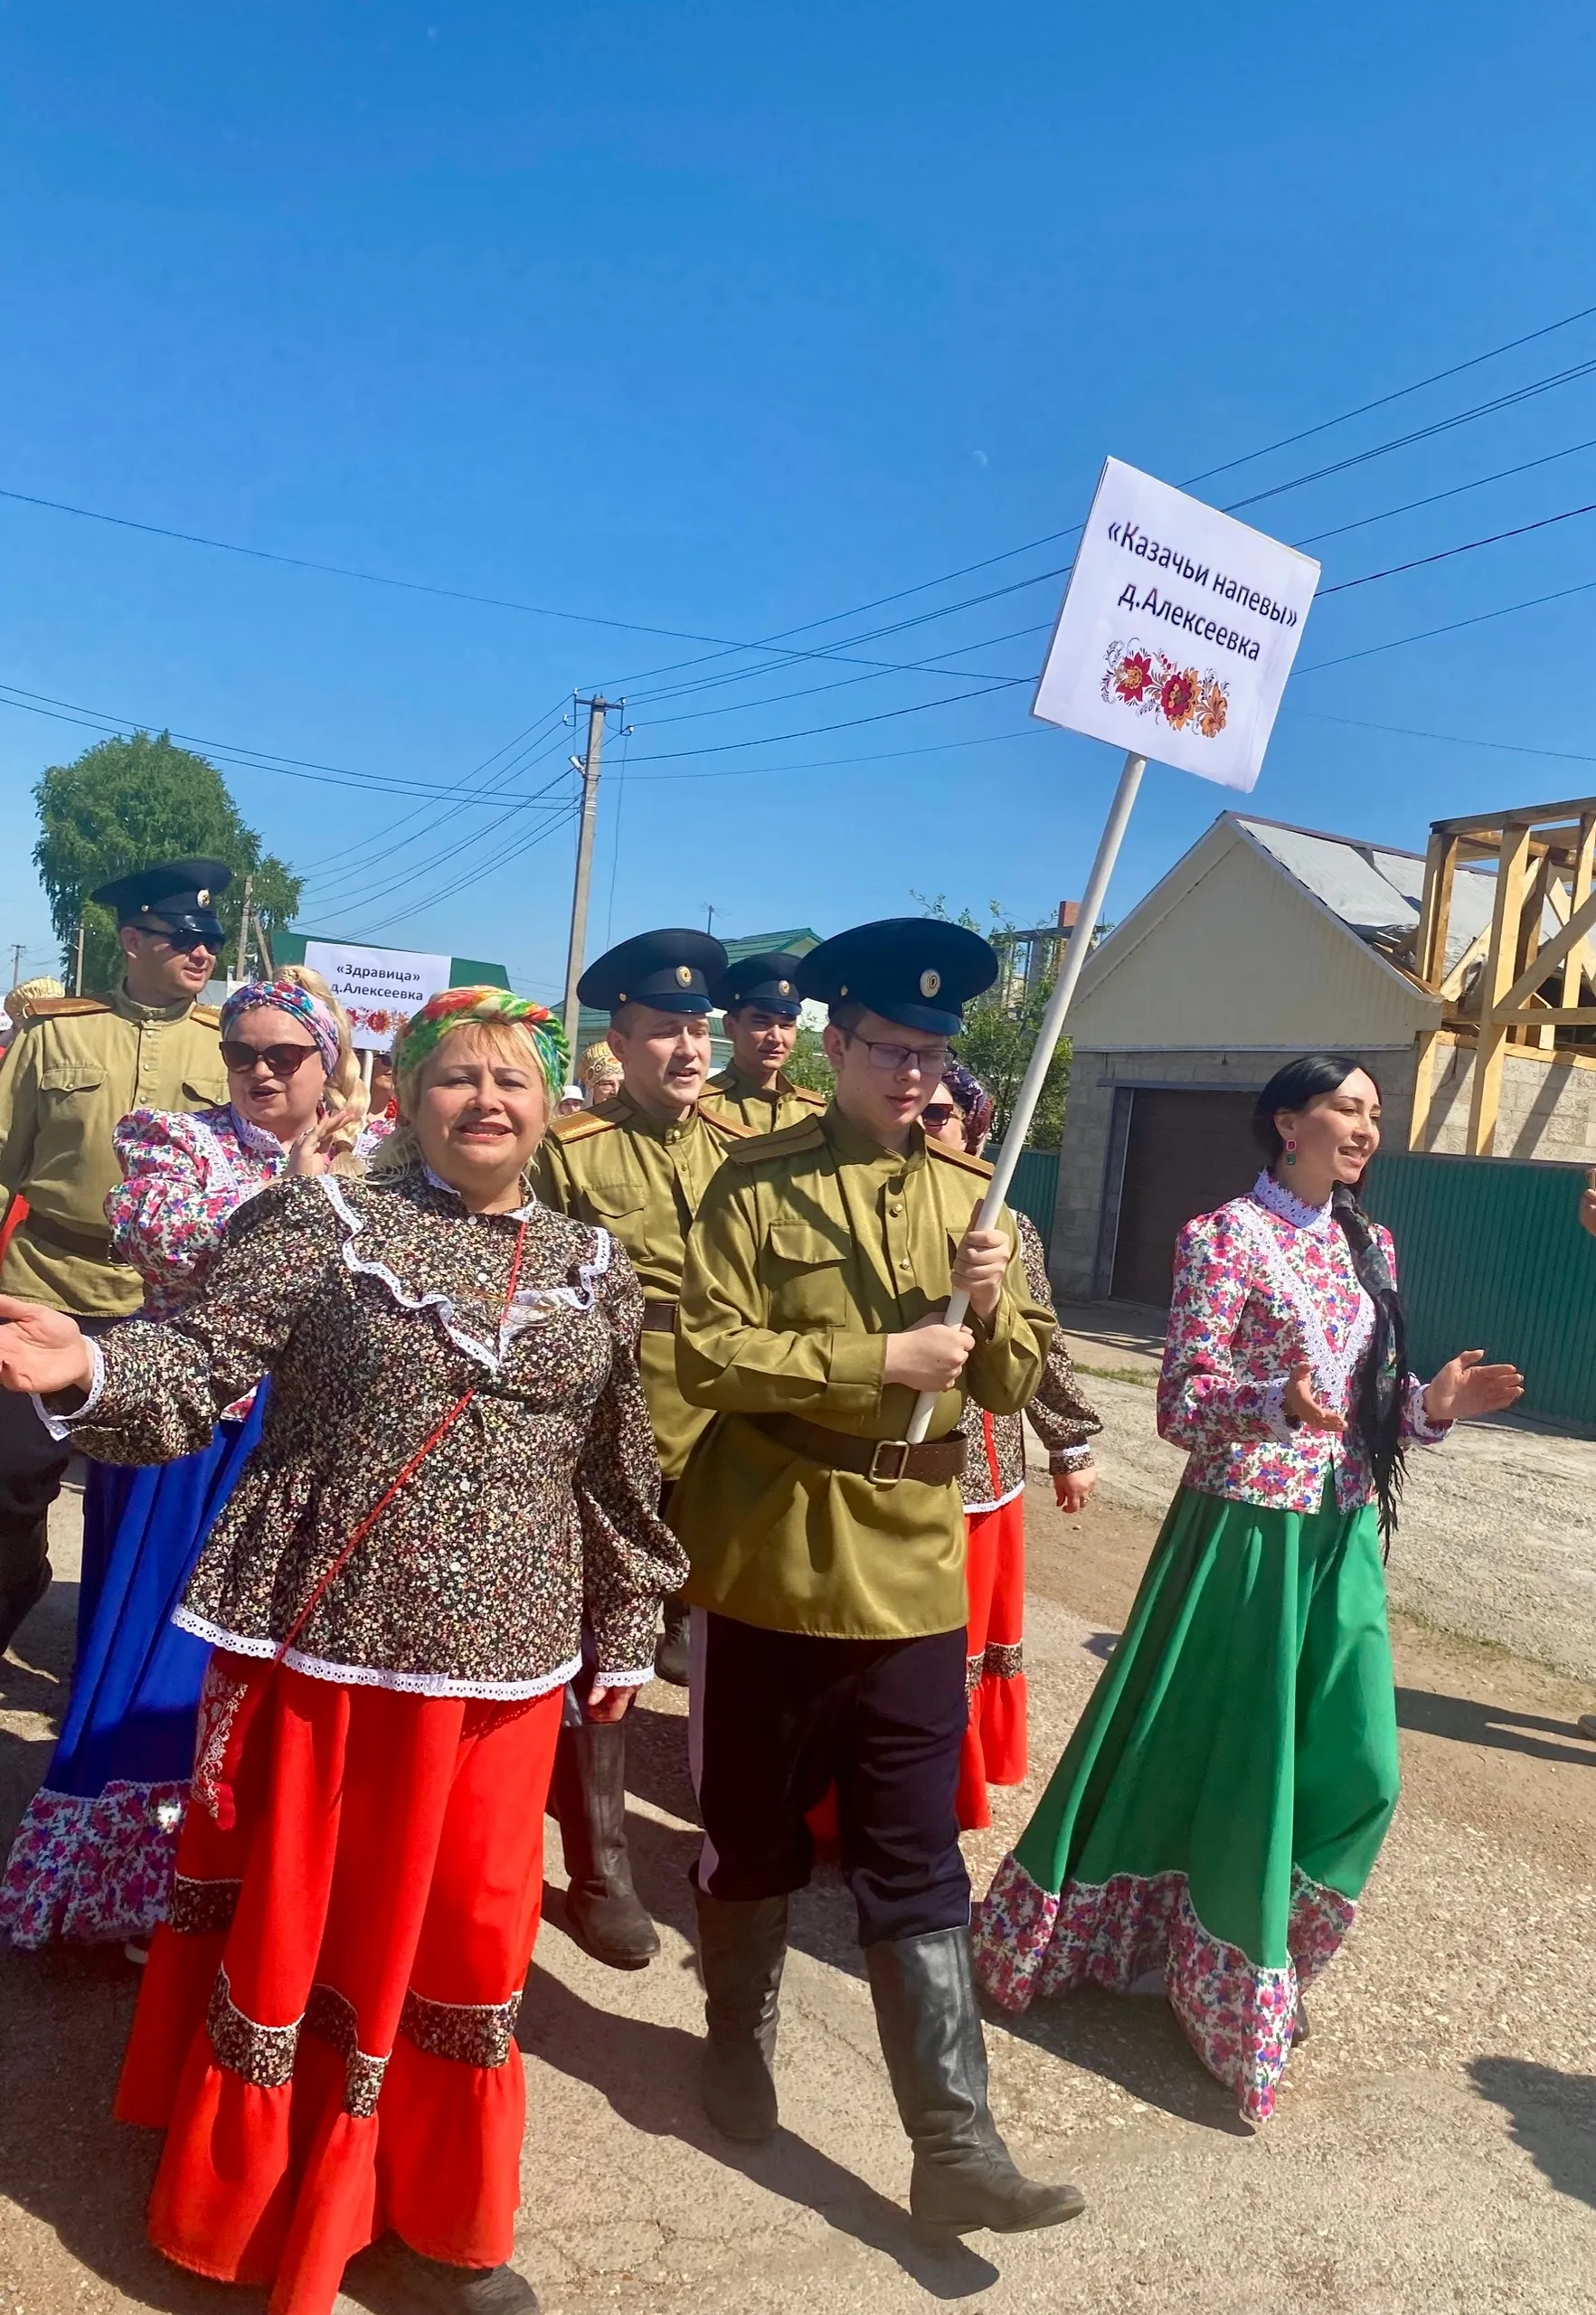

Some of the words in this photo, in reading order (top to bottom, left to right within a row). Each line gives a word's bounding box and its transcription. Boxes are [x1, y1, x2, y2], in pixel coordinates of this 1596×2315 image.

[1108, 521, 1210, 587] «Казачьи
[1213, 572, 1299, 628] напевы»
[1118, 582, 1261, 661] д.Алексеевка
[331, 982, 423, 1001] д.Алексеевка
[336, 963, 420, 982] «Здравица»
